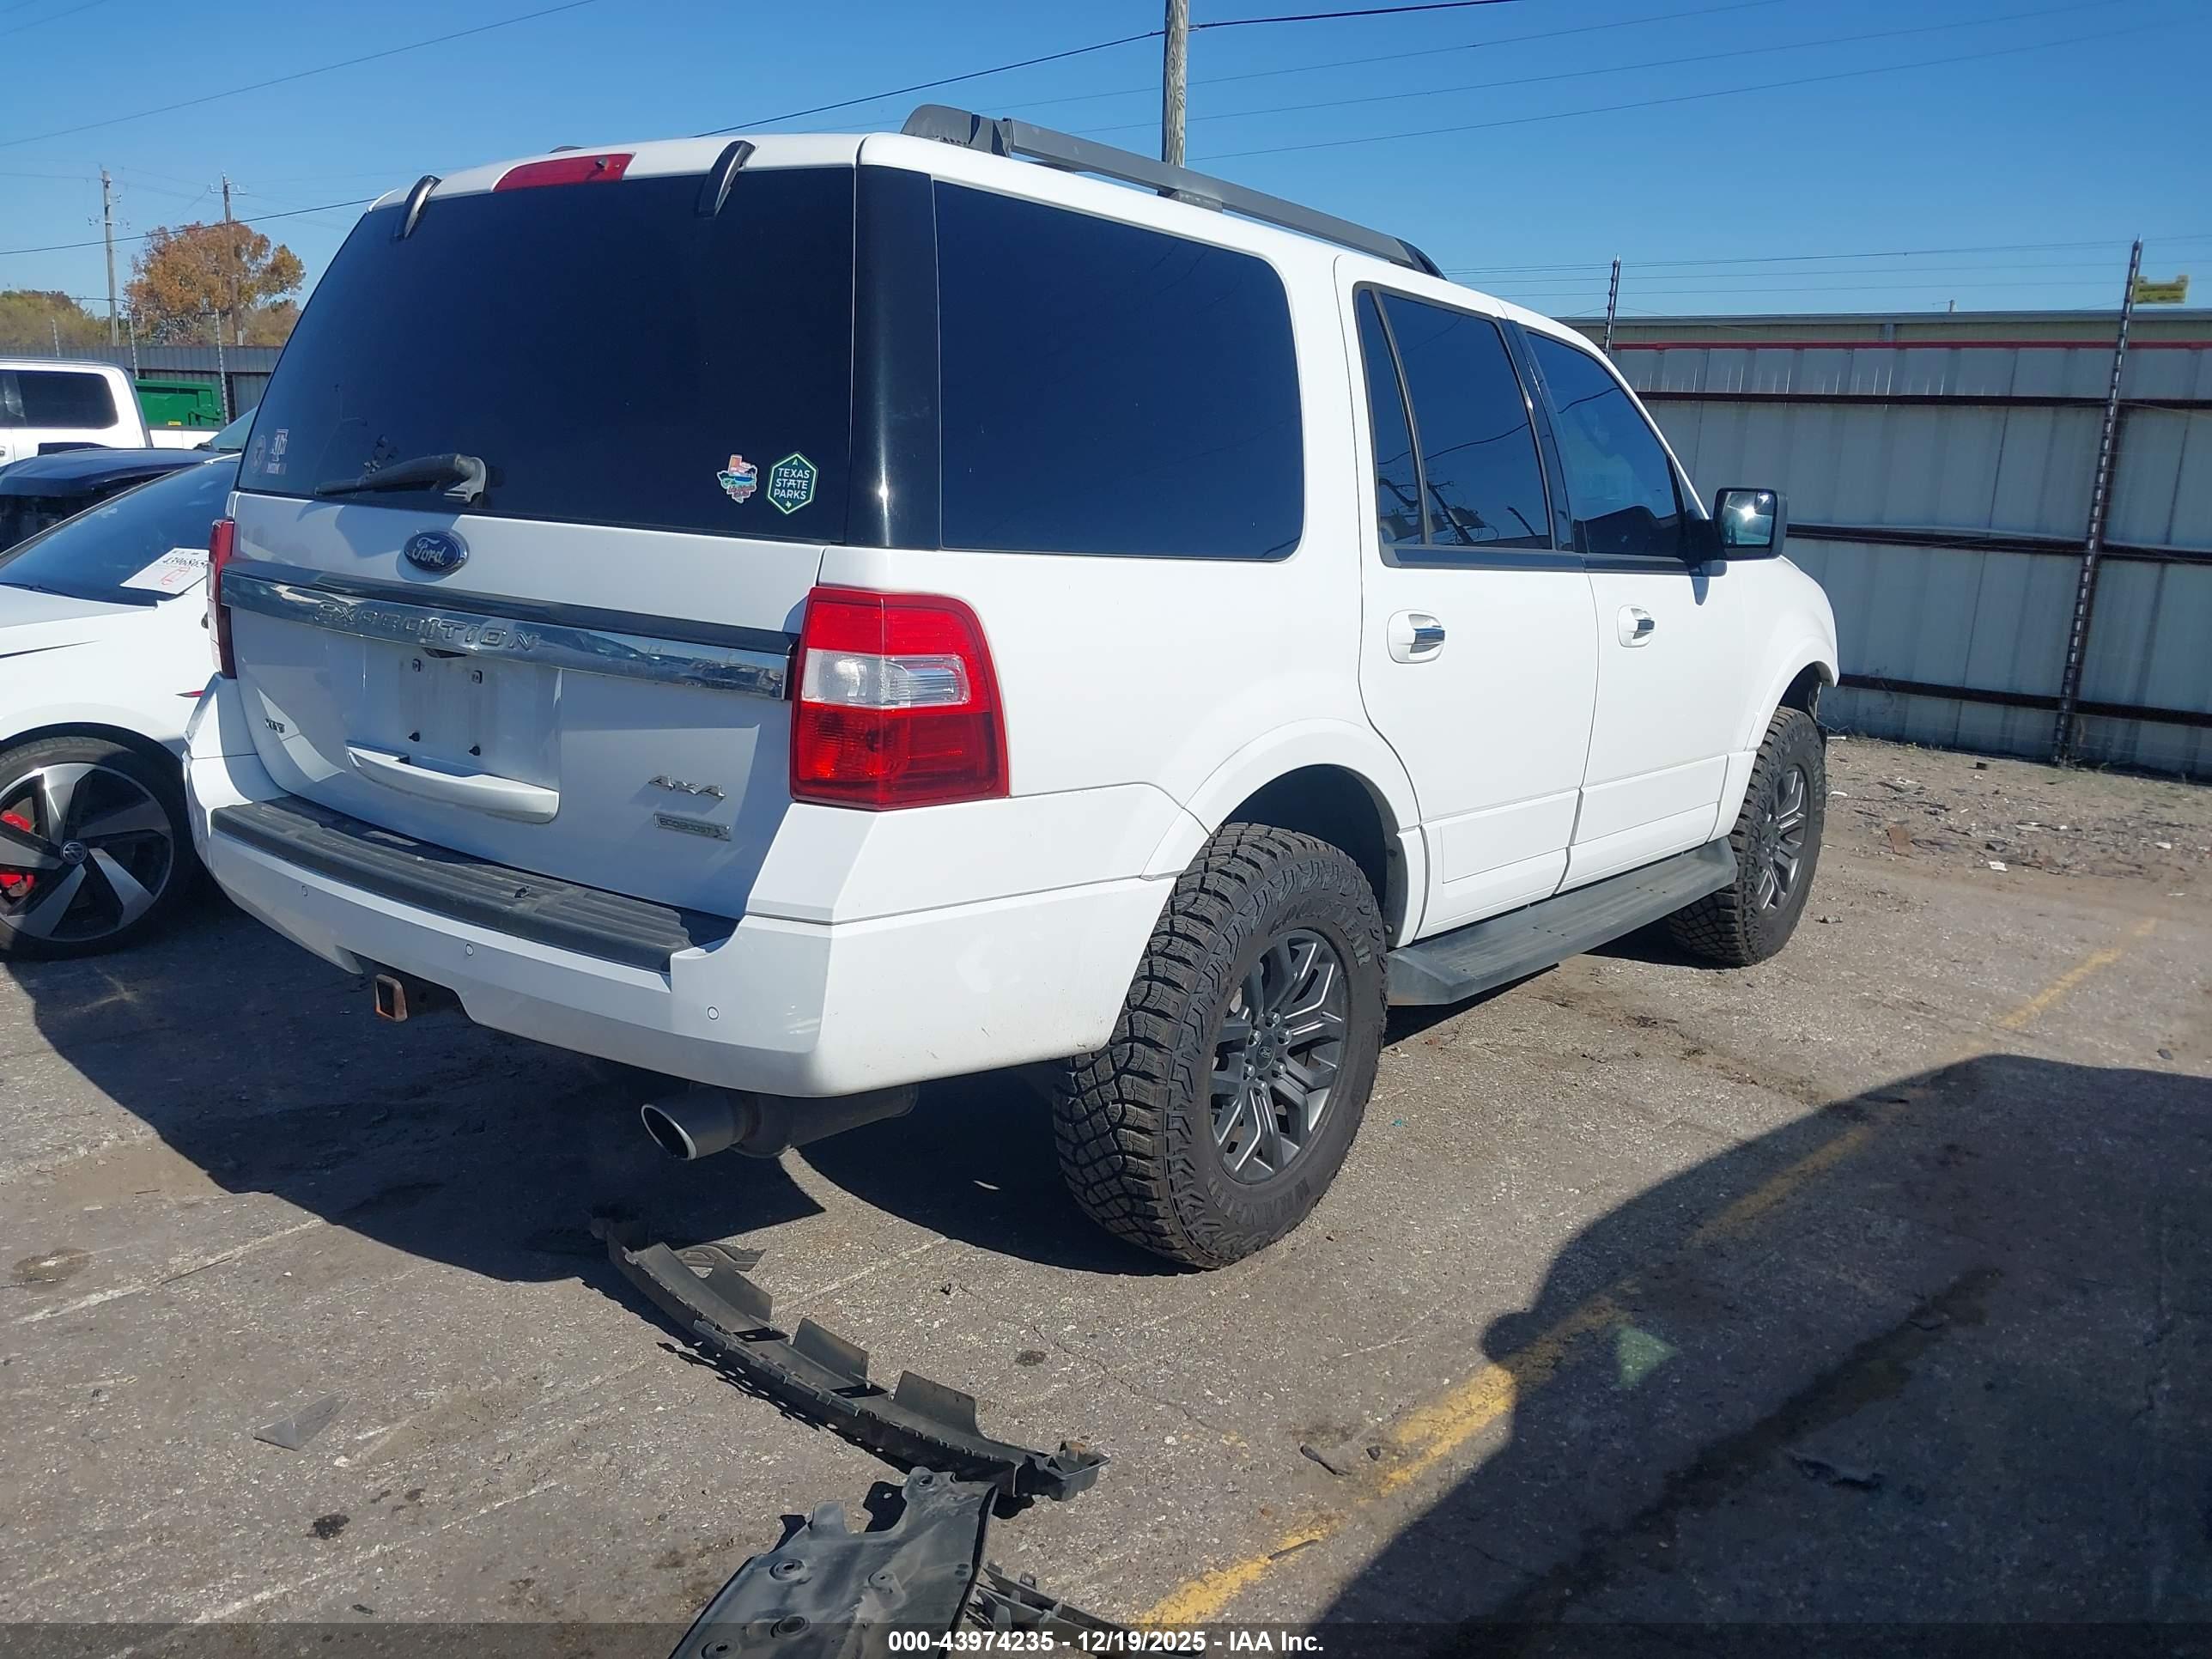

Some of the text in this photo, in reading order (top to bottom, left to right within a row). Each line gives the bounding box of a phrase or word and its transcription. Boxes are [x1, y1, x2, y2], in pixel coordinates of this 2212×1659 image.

[778, 467, 811, 479] TEXAS
[775, 478, 808, 490] STATE
[774, 489, 806, 501] PARKS
[412, 537, 447, 564] Ford
[313, 600, 542, 652] EXPEDITION
